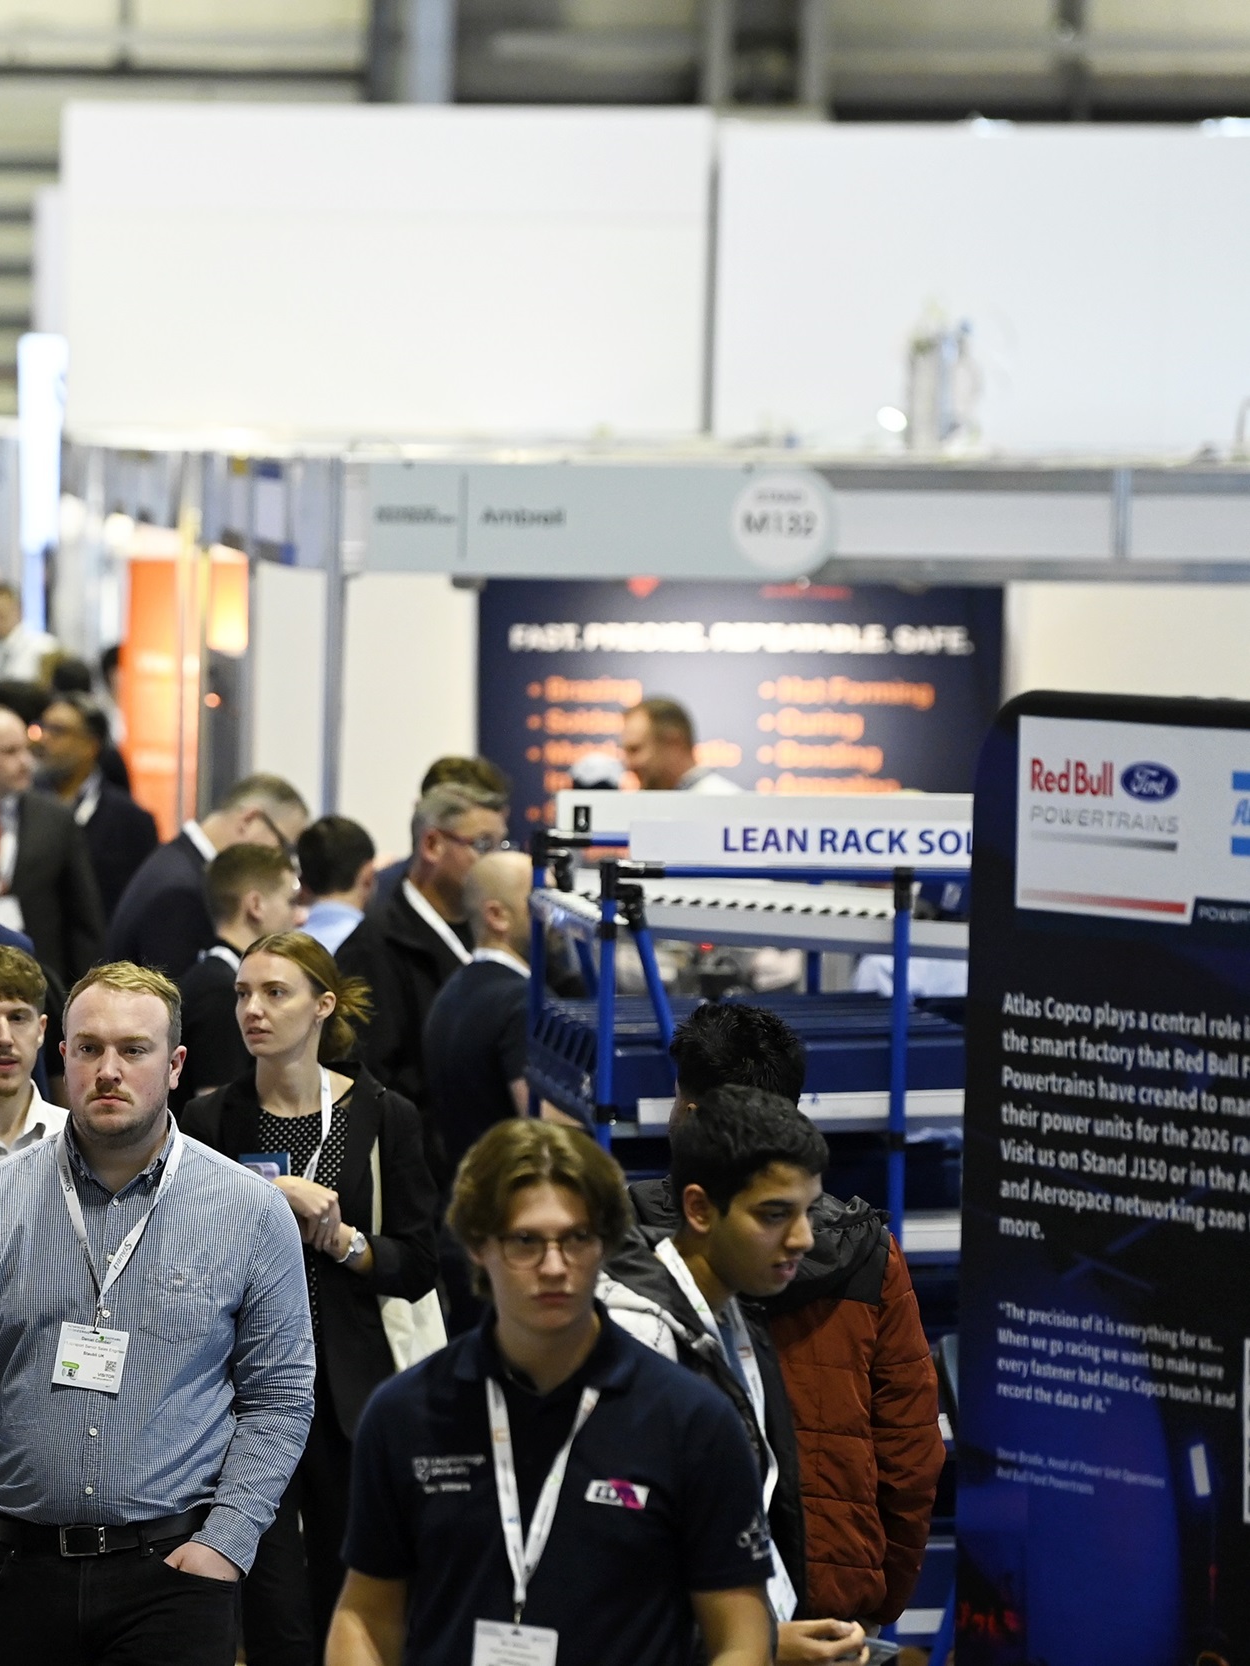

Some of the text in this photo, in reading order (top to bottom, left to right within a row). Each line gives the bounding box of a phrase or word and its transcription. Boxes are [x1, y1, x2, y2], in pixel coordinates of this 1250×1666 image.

[1129, 766, 1169, 797] Ford
[722, 827, 809, 853] LEAN
[819, 828, 908, 854] RACK
[1030, 804, 1179, 834] POWERTRAINS
[1002, 992, 1041, 1018] Atlas
[1044, 996, 1091, 1027] Copco
[1093, 1001, 1136, 1032] plays
[1138, 1011, 1148, 1030] a
[1151, 1011, 1206, 1036] central
[1210, 1014, 1242, 1040] role
[1002, 1028, 1029, 1053] the
[1031, 1036, 1077, 1059] smart
[1079, 1035, 1135, 1071] factory
[1137, 1043, 1171, 1071] that
[1174, 1048, 1204, 1074] Red
[1207, 1052, 1239, 1078] Bull
[1002, 1065, 1095, 1099] Powertrains
[1097, 1075, 1136, 1104] have
[1138, 1086, 1198, 1111] created
[1200, 1091, 1218, 1114] to
[1001, 1101, 1039, 1128] their
[1041, 1111, 1091, 1135] power
[1093, 1113, 1133, 1141] units
[1136, 1116, 1160, 1144] for
[1162, 1121, 1189, 1148] the
[1191, 1126, 1230, 1153] 2026
[1000, 1139, 1035, 1165] Visit
[1037, 1148, 1056, 1168] us
[1058, 1150, 1079, 1170] on
[1081, 1149, 1126, 1177] Stand
[1130, 1156, 1167, 1183] J150
[1170, 1165, 1187, 1185] or
[1190, 1161, 1206, 1188] in
[1208, 1165, 1236, 1192] the
[999, 1217, 1046, 1240] more.
[1000, 1177, 1246, 1232] and Aerospace networking zone
[1027, 1308, 1080, 1330] precision
[1081, 1314, 1093, 1331] of
[1094, 1314, 1103, 1334] it
[1105, 1316, 1115, 1336] is
[1116, 1323, 1178, 1350] everything
[1179, 1328, 1197, 1348] for
[997, 1328, 1224, 1380] When we go racing we want to make sure
[997, 1358, 1236, 1410] every fastener had Atlas Copco touch it and
[997, 1383, 1033, 1401] record
[1034, 1386, 1053, 1404] the
[1054, 1390, 1080, 1409] data
[1081, 1393, 1093, 1411] of
